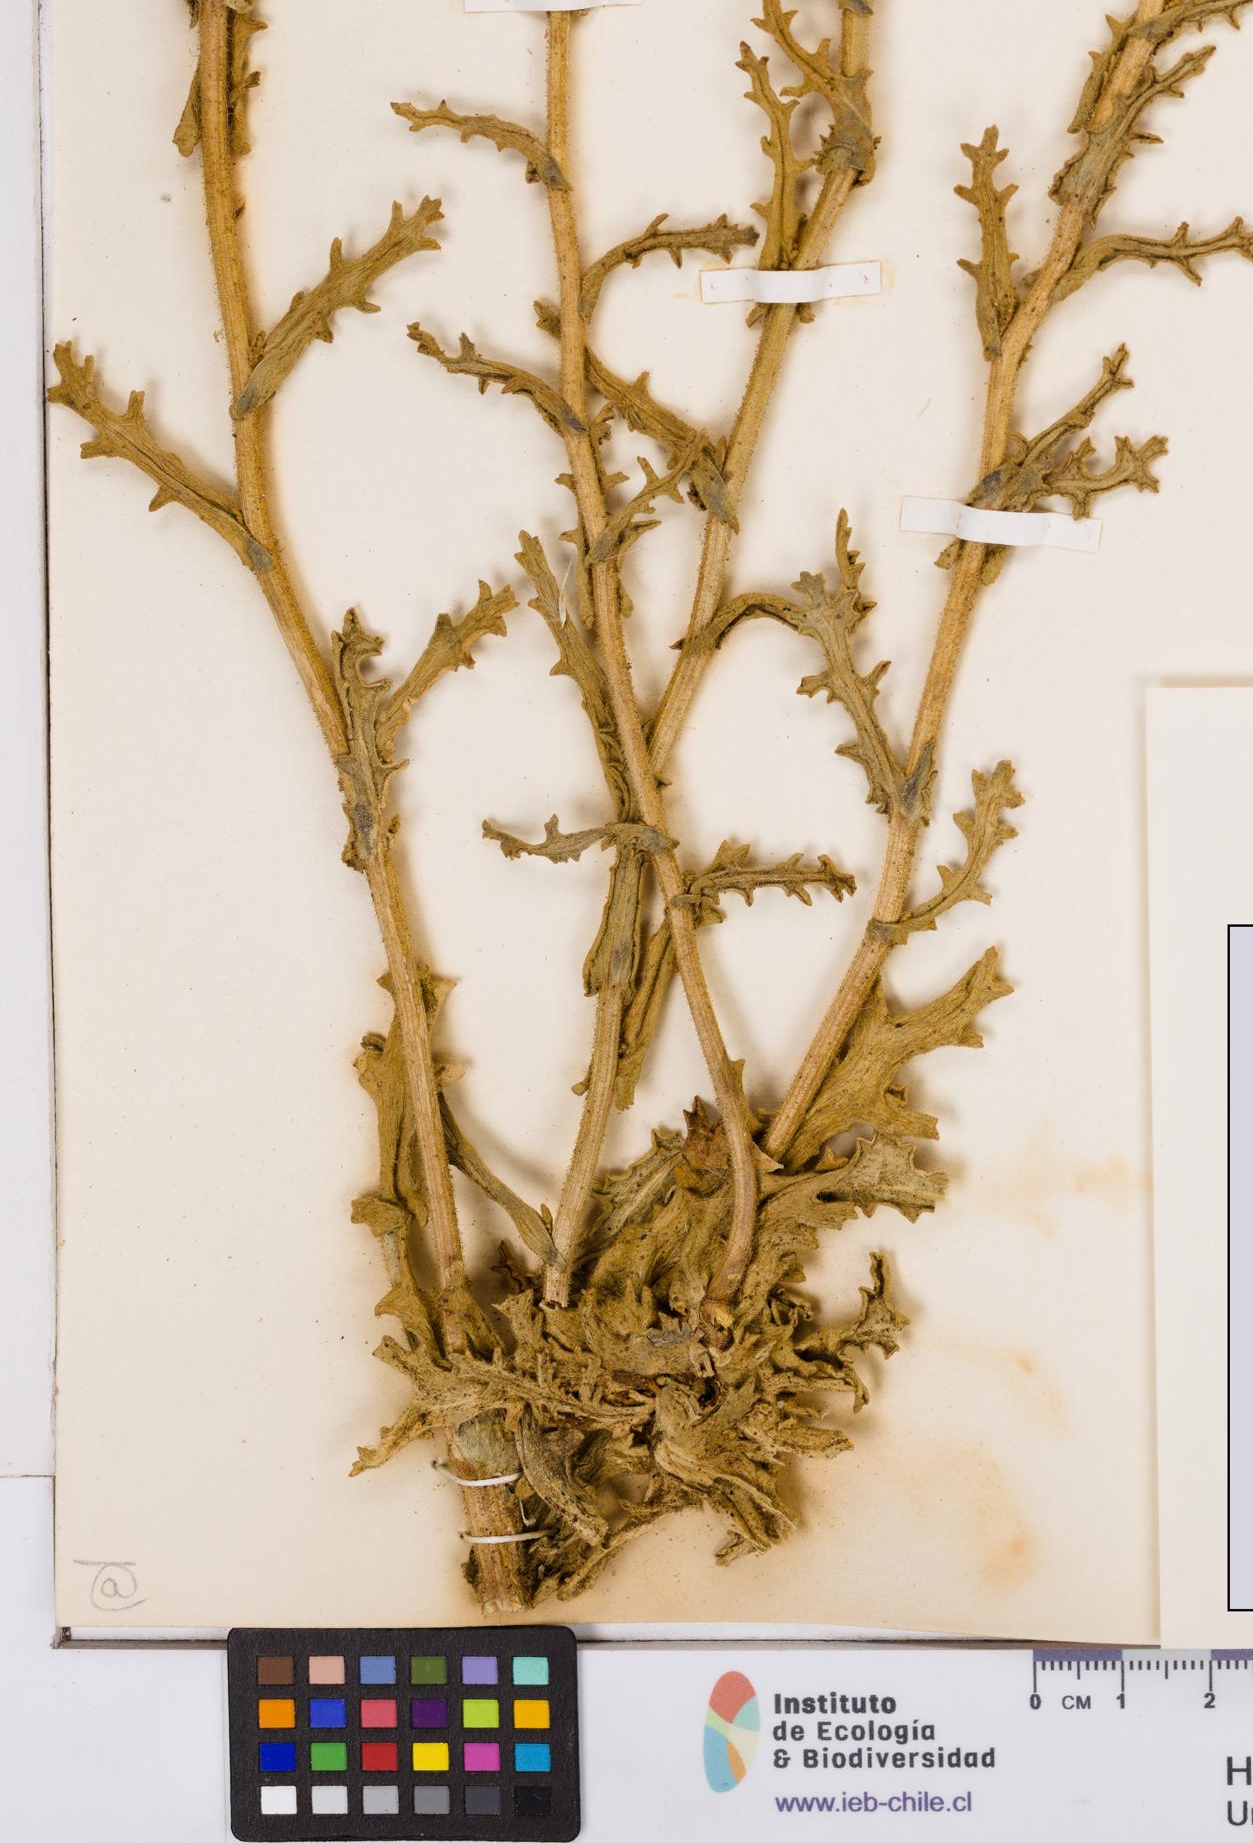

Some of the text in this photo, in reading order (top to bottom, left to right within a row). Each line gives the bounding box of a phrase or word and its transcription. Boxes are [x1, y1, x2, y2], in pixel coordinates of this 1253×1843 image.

[773, 1690, 897, 1715] Instituto
[1029, 1694, 1042, 1711] 0
[1061, 1694, 1092, 1711] CM
[1115, 1693, 1126, 1710] 1
[1203, 1693, 1216, 1710] 2
[771, 1718, 936, 1746] de Ecología
[772, 1743, 996, 1770] & Biodiversidad
[774, 1790, 972, 1813] www.ieb-chile.cl
